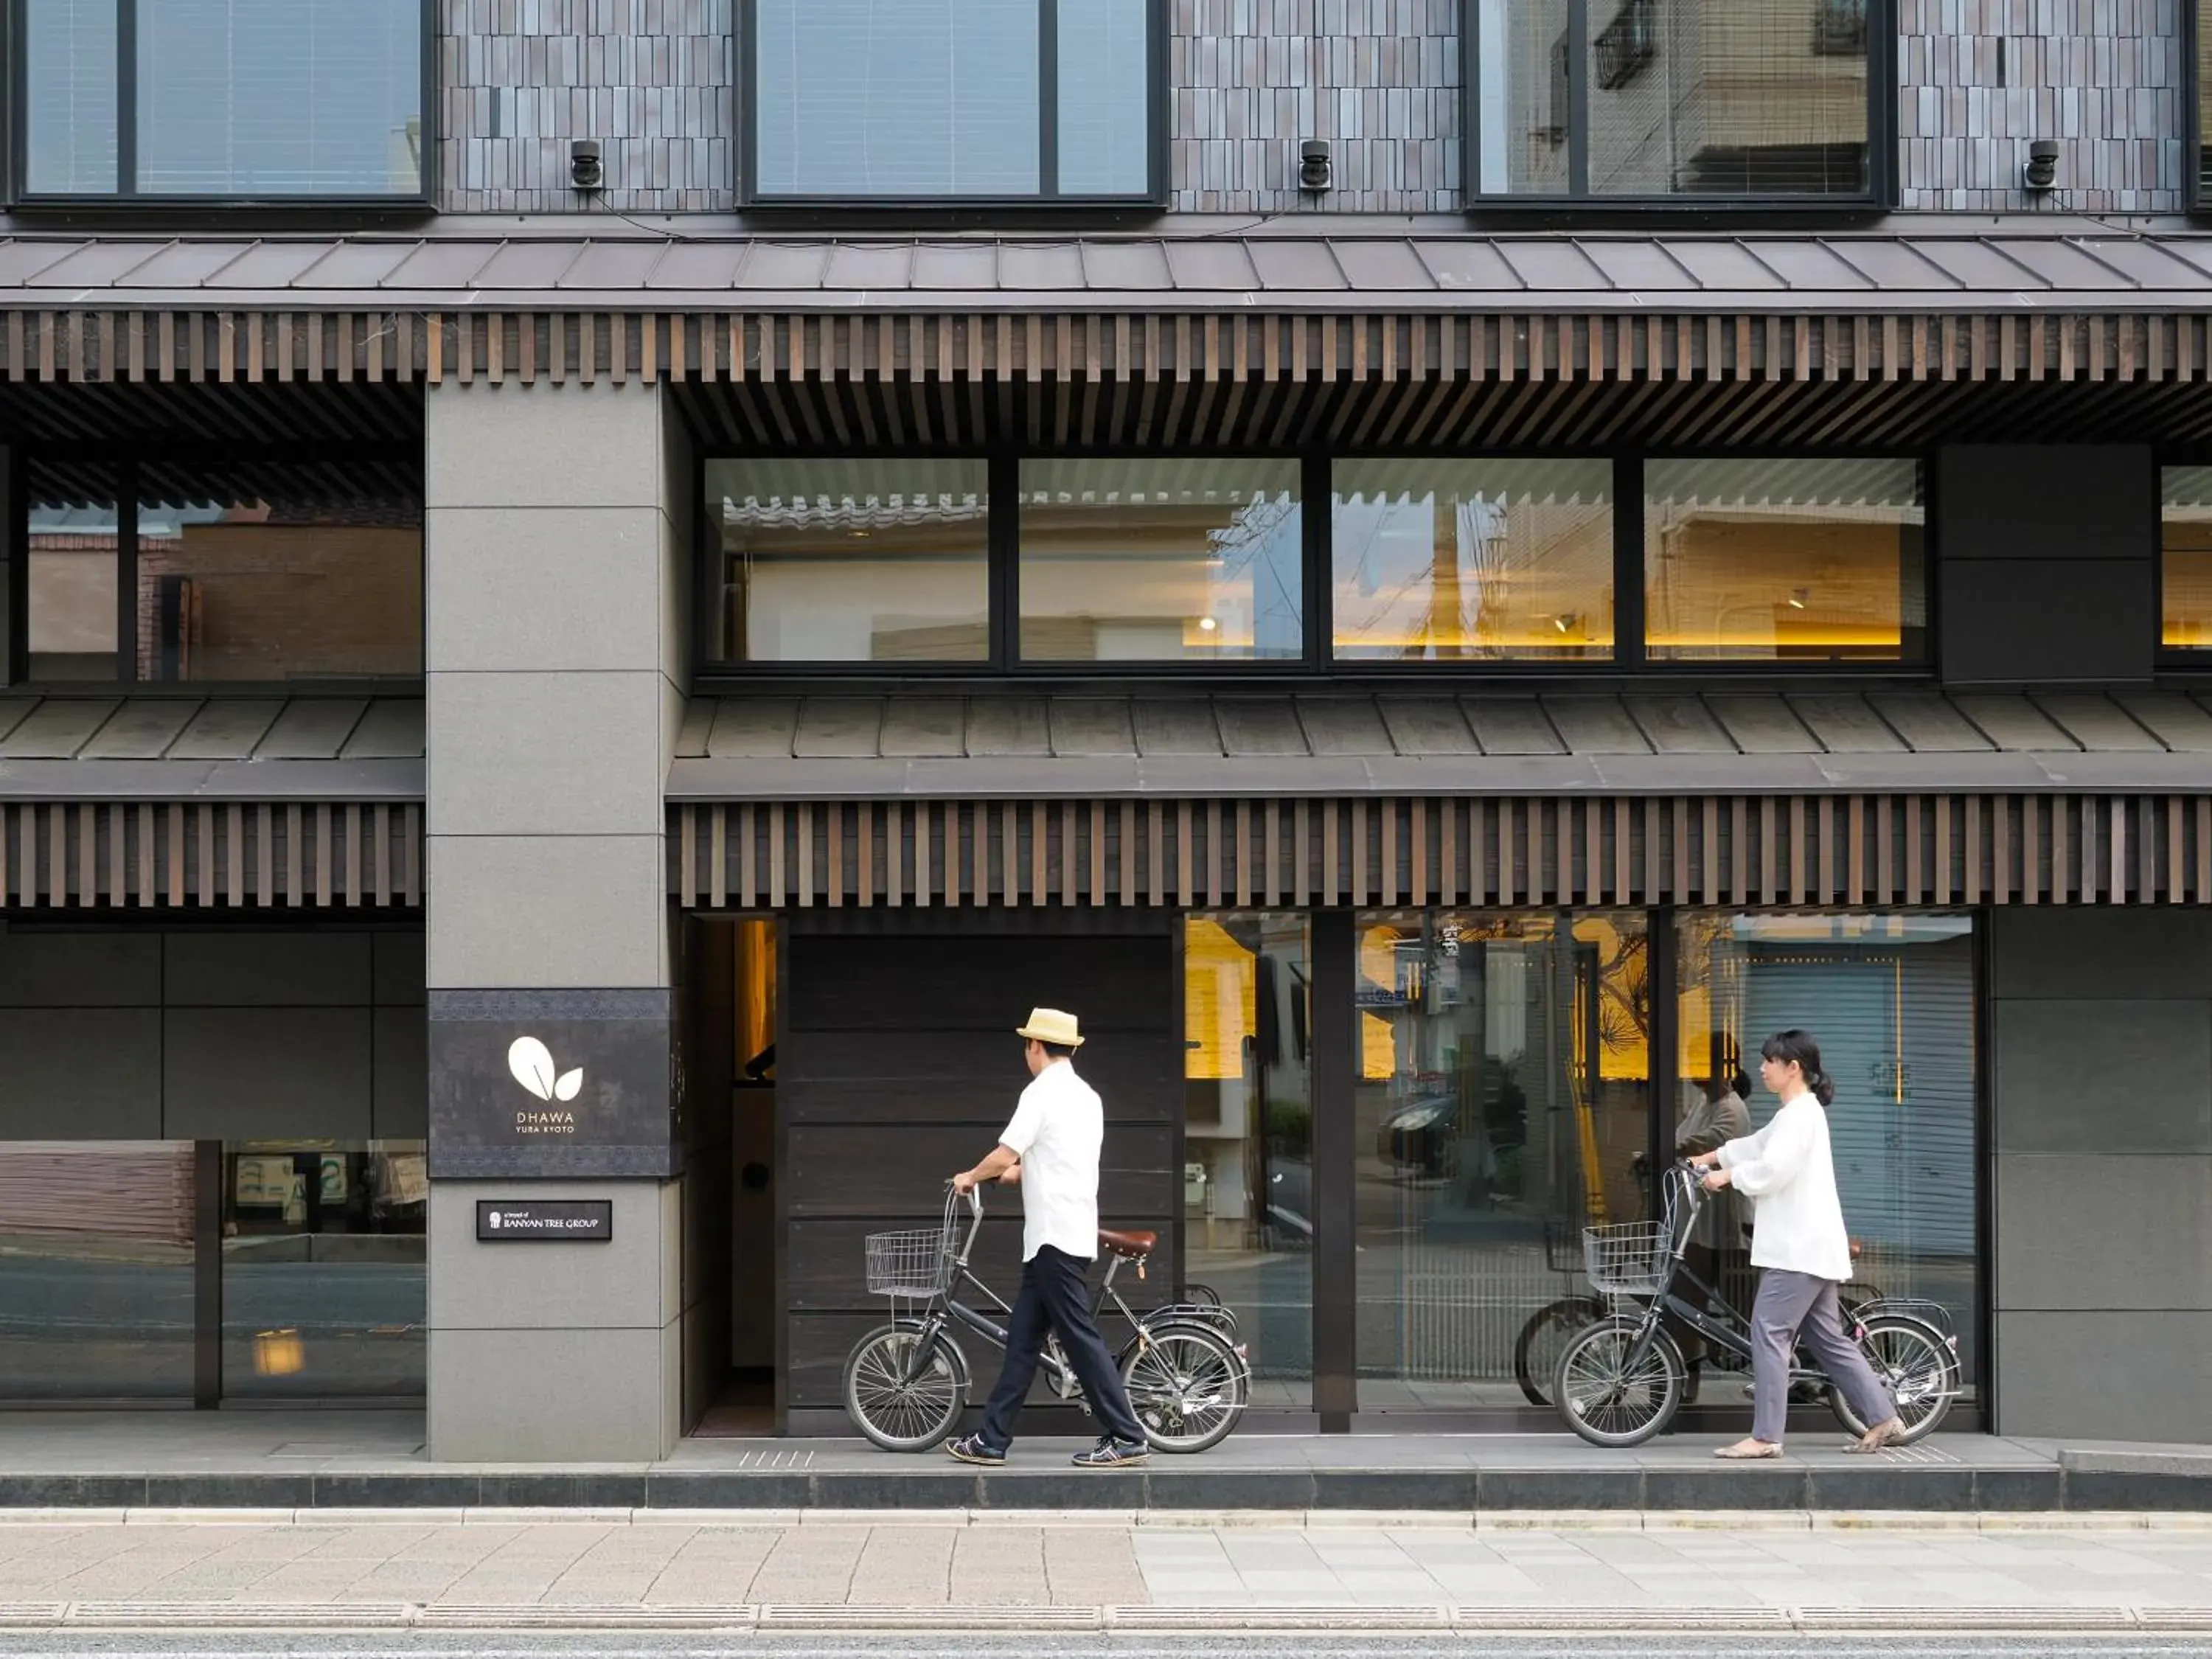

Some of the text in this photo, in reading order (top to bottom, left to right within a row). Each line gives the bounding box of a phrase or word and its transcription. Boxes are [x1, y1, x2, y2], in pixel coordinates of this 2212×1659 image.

[517, 1112, 574, 1123] DHAWA
[504, 1219, 599, 1229] BANYAN TREE GROUP
